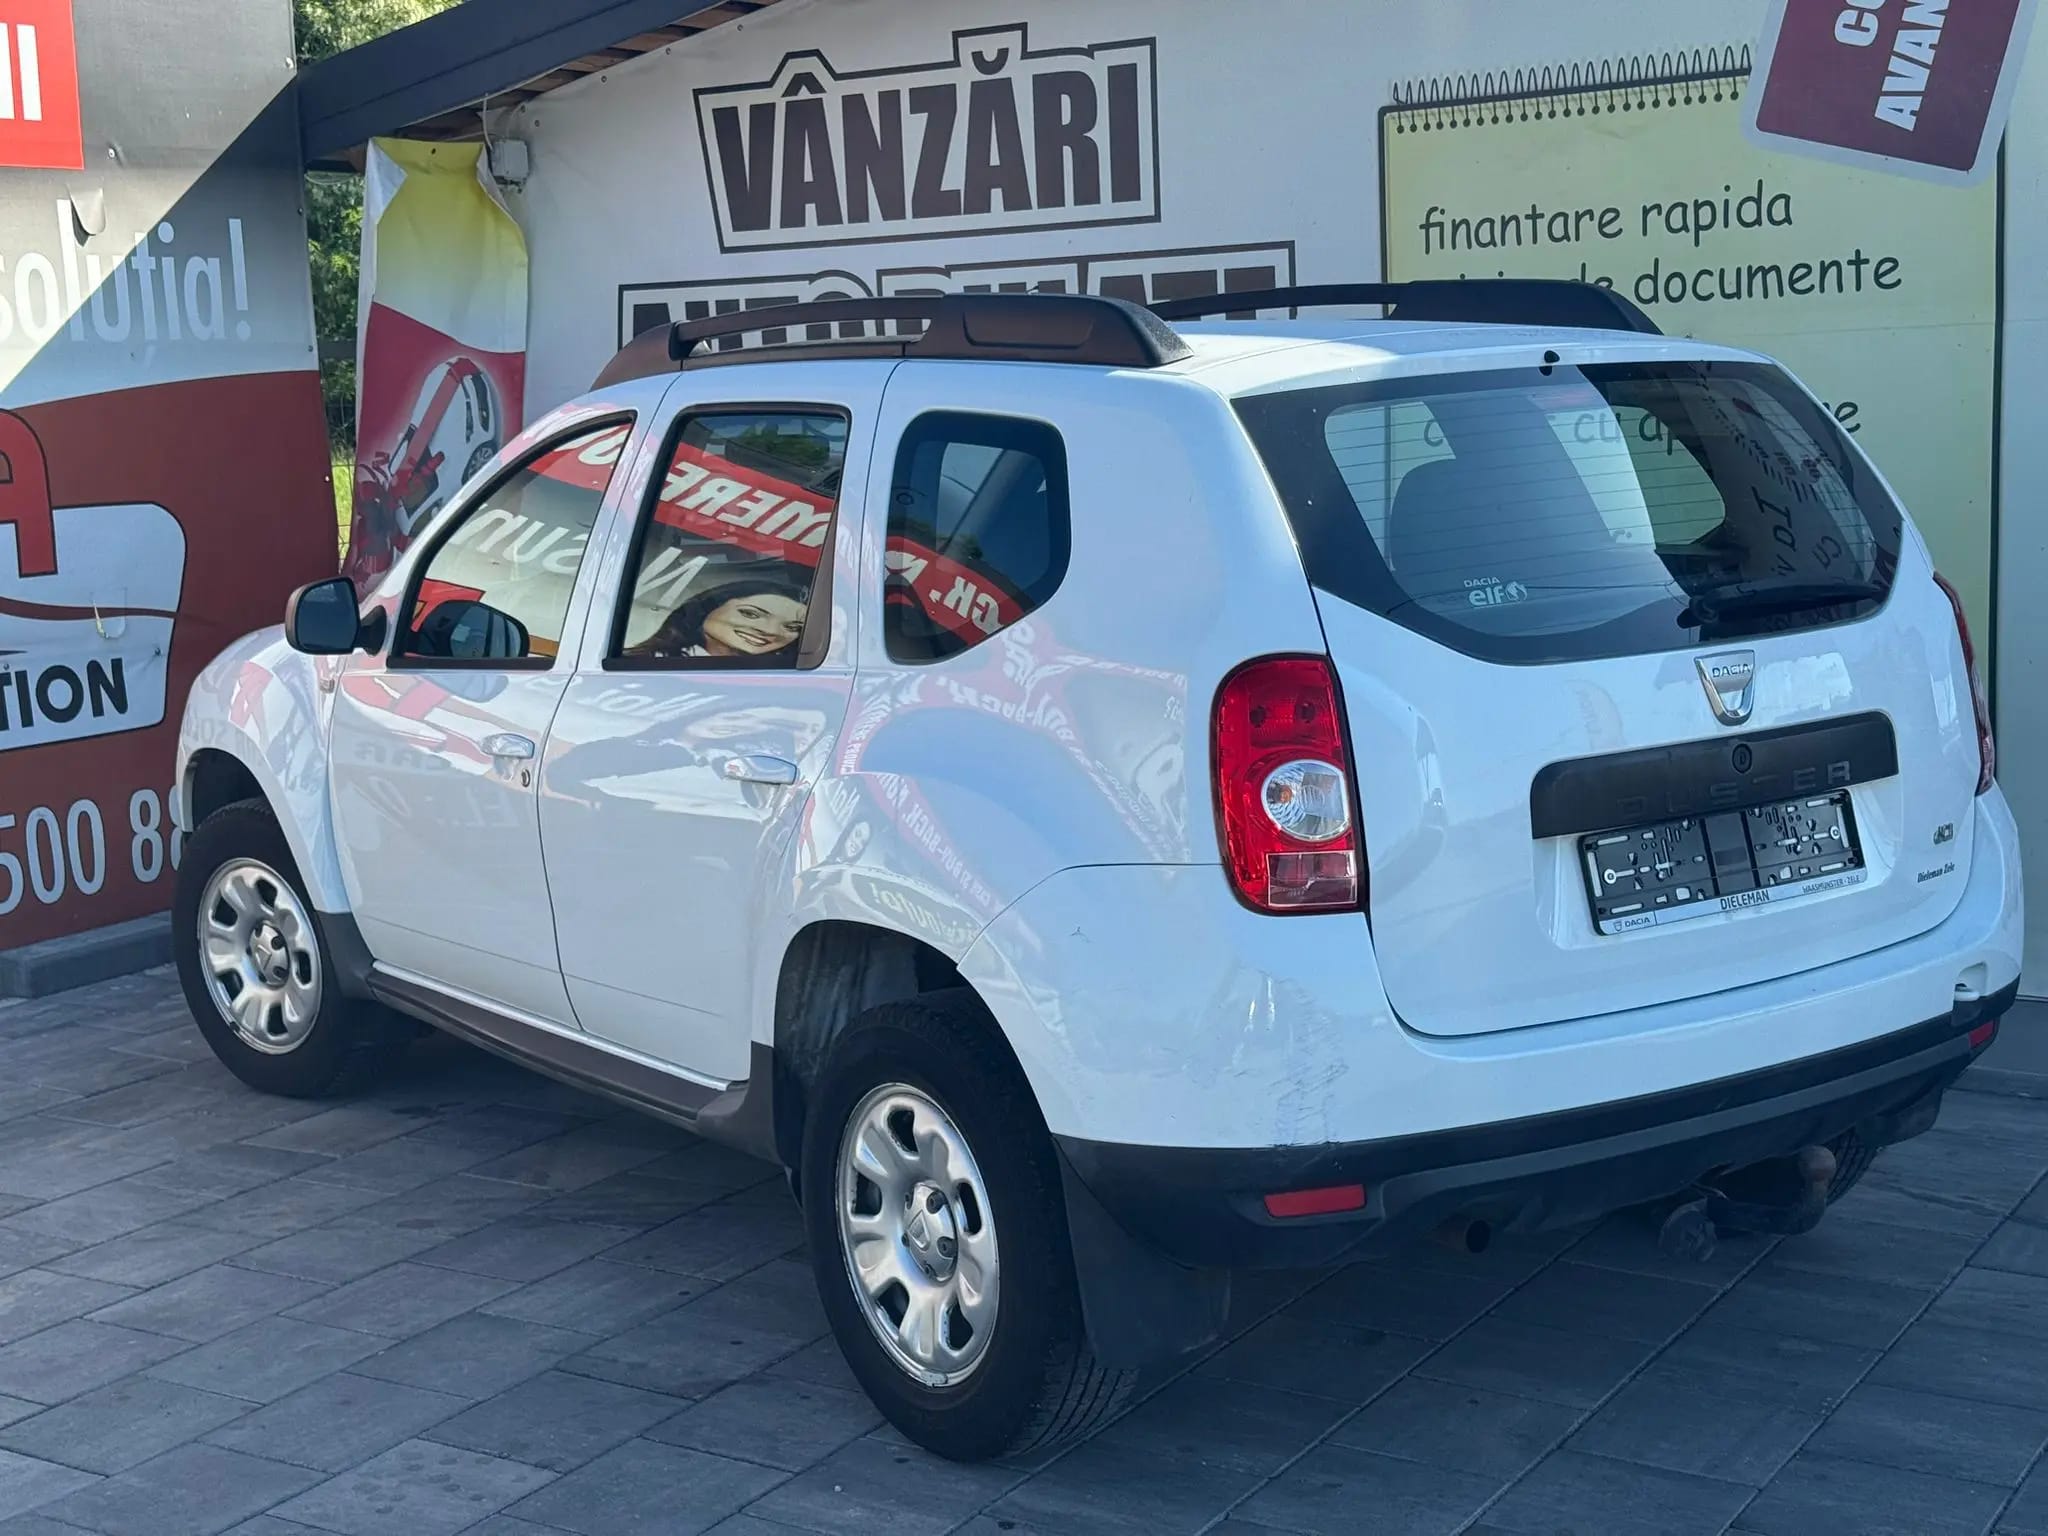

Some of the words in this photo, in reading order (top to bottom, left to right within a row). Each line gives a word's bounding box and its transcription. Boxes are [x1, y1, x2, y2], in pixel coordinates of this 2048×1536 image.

[711, 47, 1142, 232] VÂNZĂRI
[1419, 203, 1623, 255] finantare
[1641, 178, 1793, 248] rapida
[1633, 249, 1903, 305] documente
[1463, 576, 1501, 588] DACIA
[1468, 585, 1504, 606] elf
[1712, 663, 1752, 678] DACIA
[1720, 890, 1770, 911] DIELEMAN
[1624, 917, 1651, 928] DACIA
